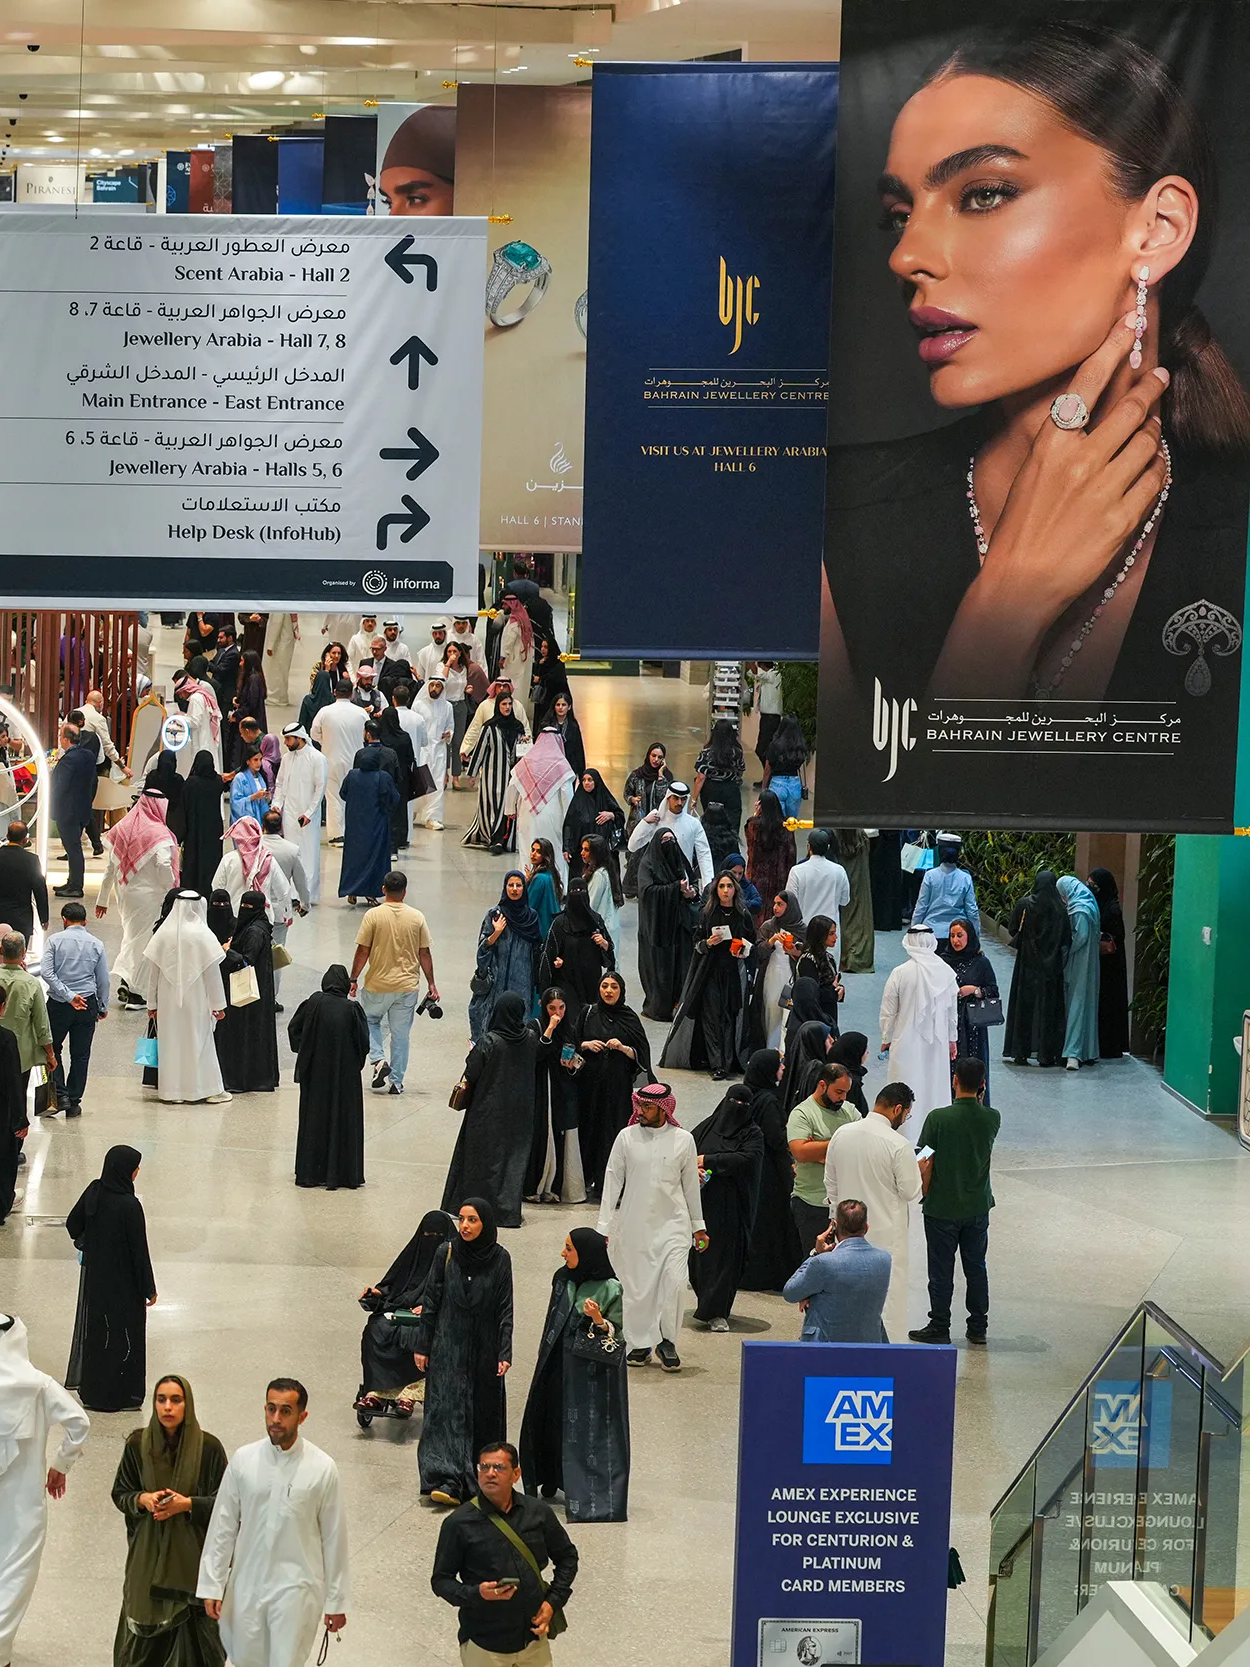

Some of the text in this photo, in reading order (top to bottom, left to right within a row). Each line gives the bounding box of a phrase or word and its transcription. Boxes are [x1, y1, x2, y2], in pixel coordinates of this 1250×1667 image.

[90, 236, 99, 251] 2
[104, 235, 142, 251] قاعة
[160, 237, 219, 256] العربية
[222, 236, 285, 256] العطور
[291, 238, 350, 256] معرض
[174, 265, 224, 281] Scent
[228, 267, 284, 282] Arabia
[302, 267, 335, 282] Hall
[339, 268, 350, 283] 2
[69, 302, 80, 316] 8
[102, 302, 141, 316] قاعة
[157, 303, 216, 322] العربية
[218, 305, 280, 323] الجواهر
[719, 256, 760, 355] bjc
[287, 308, 346, 322] معرض
[123, 331, 202, 350] Jewellery
[206, 333, 262, 348] Arabia
[280, 333, 312, 348] Hall
[317, 334, 330, 350] 7,
[335, 334, 346, 348] 8
[66, 362, 130, 386] الشرقي
[136, 365, 196, 383] المدخل
[212, 368, 278, 388] الرئيسي
[284, 367, 346, 385] المدخل
[82, 393, 124, 408] Main
[130, 394, 208, 410] Entrance
[224, 395, 262, 410] East
[267, 396, 345, 411] Entrance
[644, 391, 830, 400] BAHRAIN JEWELLERY CENTRE
[65, 430, 75, 446] 6
[100, 430, 138, 446] قاعة
[154, 432, 212, 450] العربية
[216, 434, 278, 452] الجواهر
[284, 437, 343, 452] معرض
[641, 446, 828, 457] VISIT US AT JEWELLERY ARABIA
[109, 460, 188, 478] Jewellery
[192, 461, 248, 476] Arabia
[265, 462, 308, 477] Halls
[312, 462, 327, 480] 5,
[332, 463, 343, 478] 6
[714, 462, 756, 473] HALL 6
[182, 497, 342, 516] مكتب الاستعلامات
[500, 515, 529, 526] HALL
[534, 516, 540, 526] 6
[551, 516, 582, 526] STAN
[168, 524, 342, 543] Help Desk (InfoHub)
[393, 578, 440, 590] informa
[872, 676, 918, 783] bjc
[926, 729, 1182, 744] BAHRAIN JEWELLERY CENTRE
[771, 1488, 917, 1502] AMEX EXPERIENCE
[768, 1511, 920, 1524] LOUNGE EXCLUSIVE
[772, 1533, 914, 1548] FOR CENTURION &
[802, 1556, 882, 1570] PLATINUM
[781, 1580, 906, 1593] CARD MEMBERS
